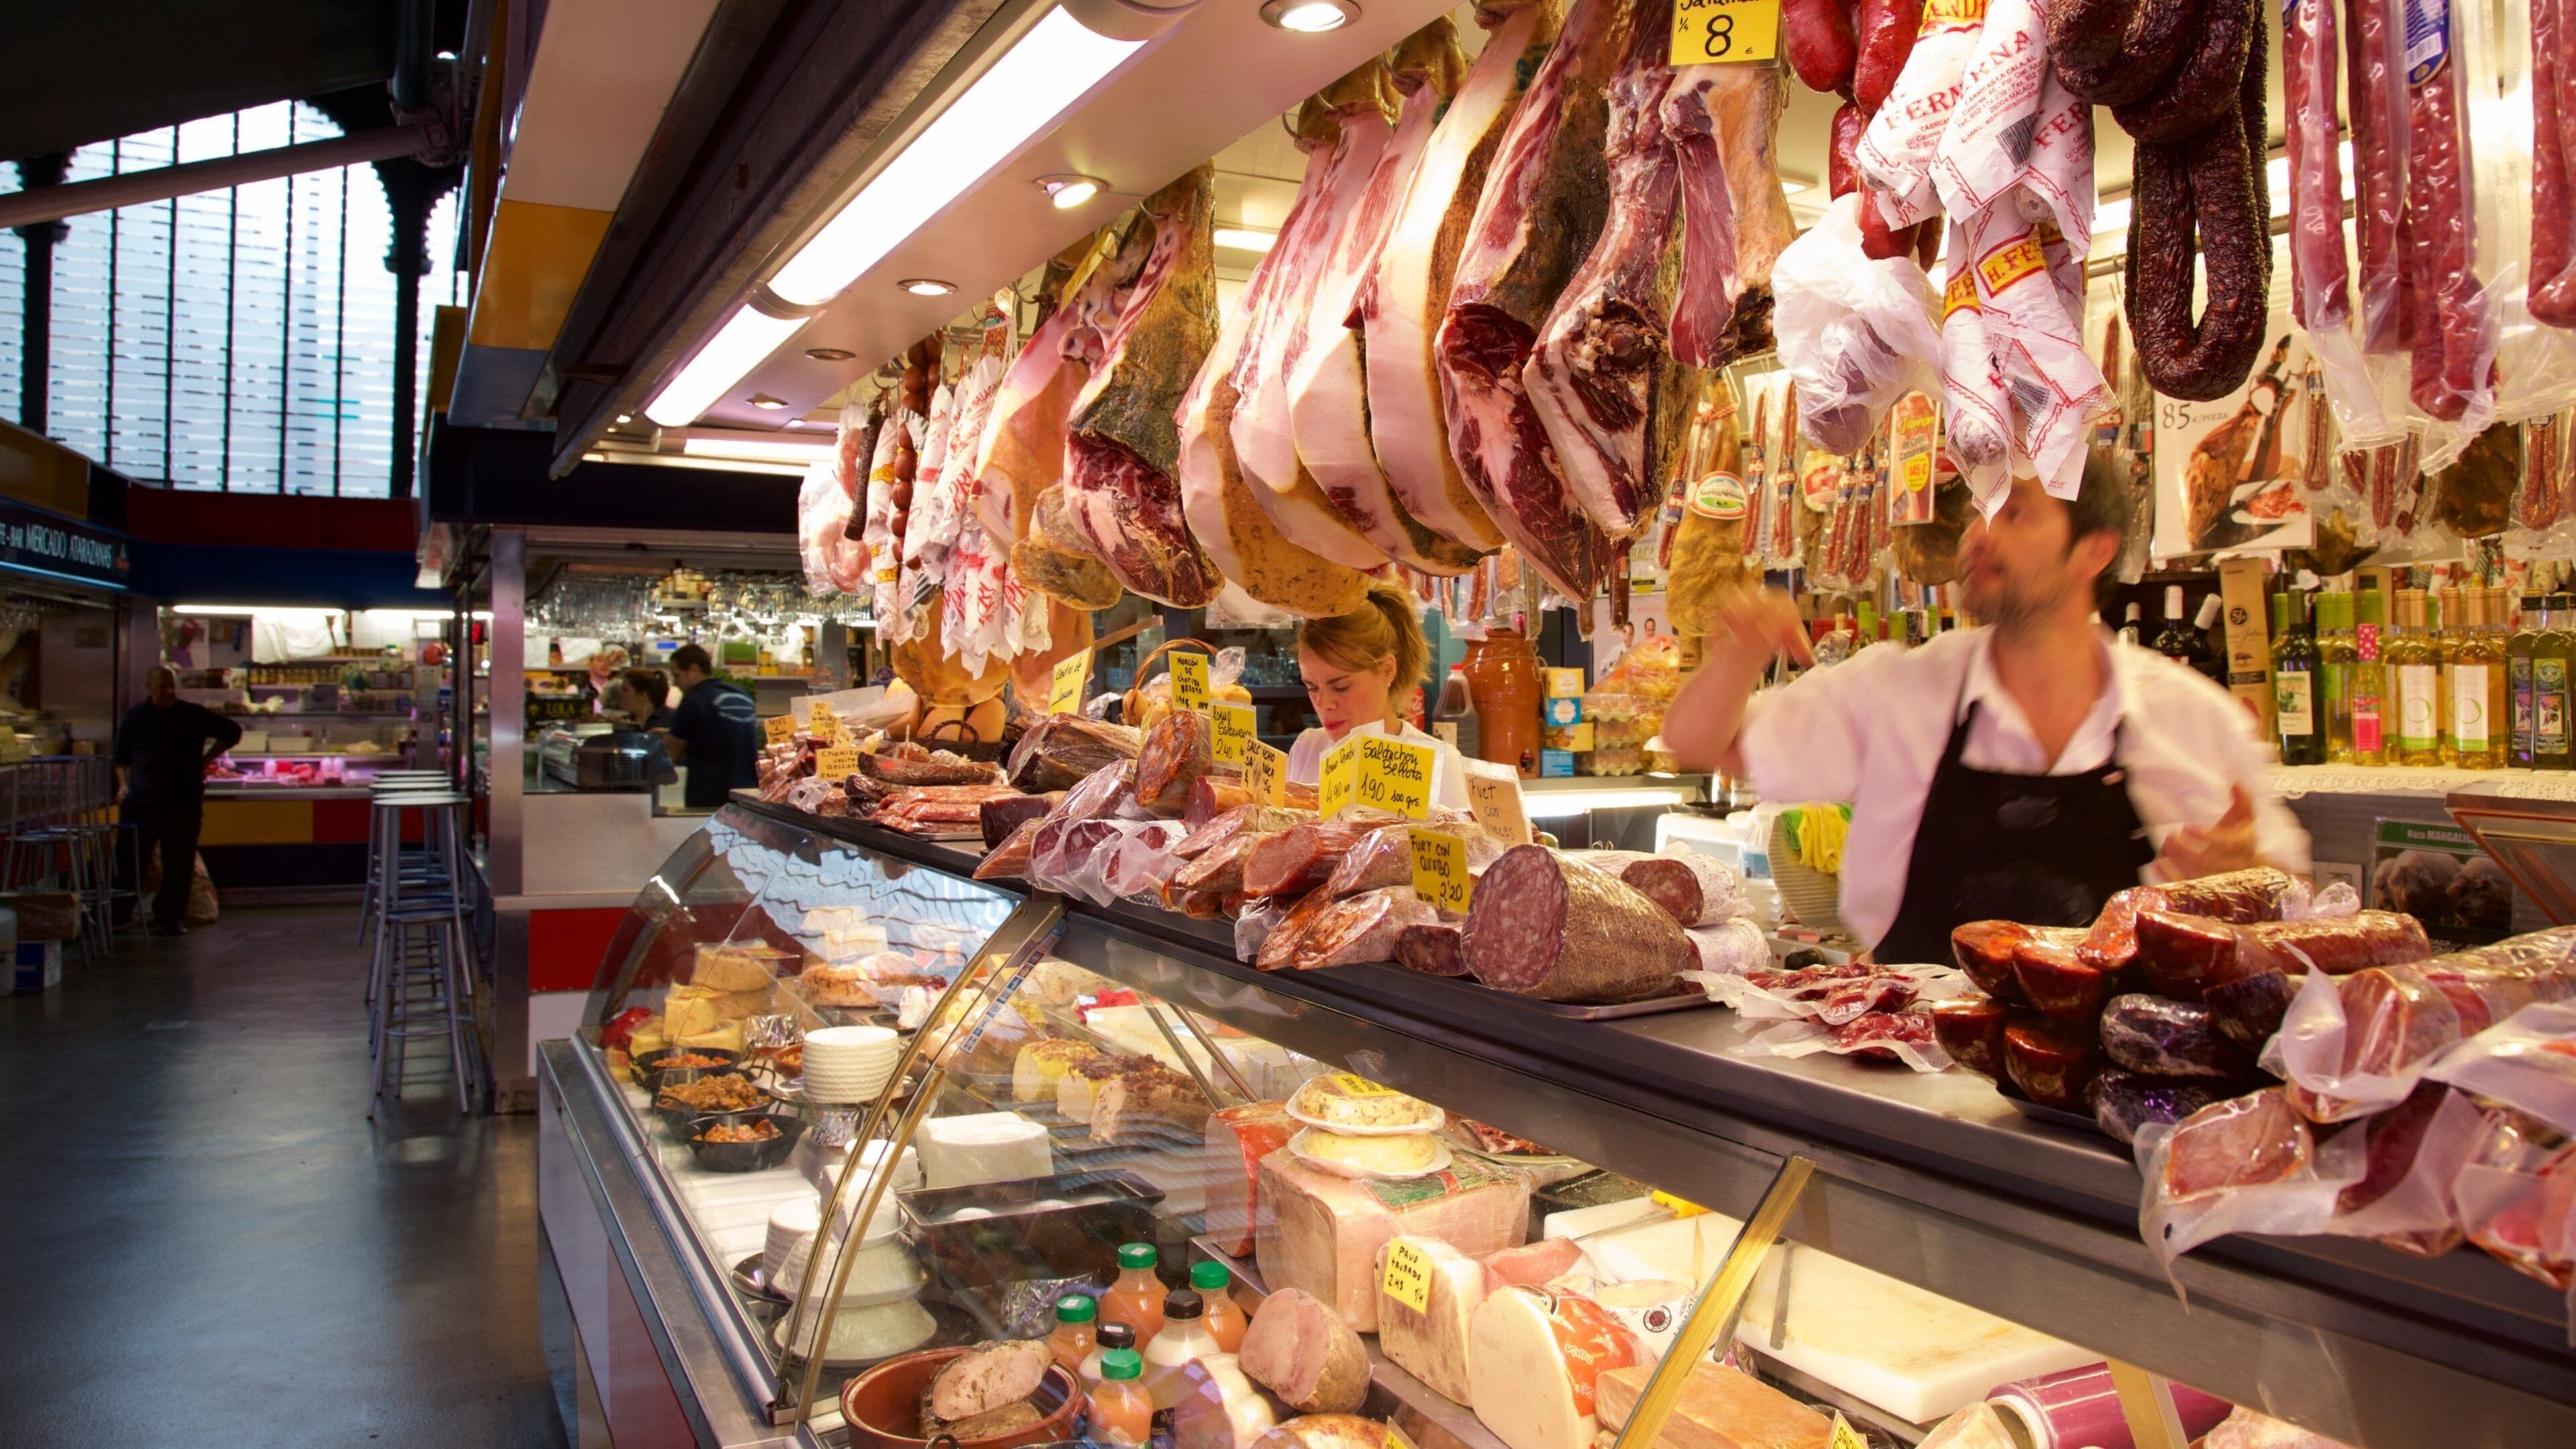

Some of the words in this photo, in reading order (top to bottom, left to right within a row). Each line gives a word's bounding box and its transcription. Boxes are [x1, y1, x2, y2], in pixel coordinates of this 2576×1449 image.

[1704, 14, 1734, 58] 8
[2162, 402, 2192, 429] 85
[26, 521, 67, 559] MERCADO
[69, 535, 113, 570] ATARAZANAS
[1382, 758, 1423, 782] Bellota
[1360, 771, 1385, 802] 1.90
[1390, 790, 1405, 803] 100
[1484, 806, 1500, 818] con
[1435, 842, 1451, 857] CON
[1399, 1245, 1419, 1264] PAVO
